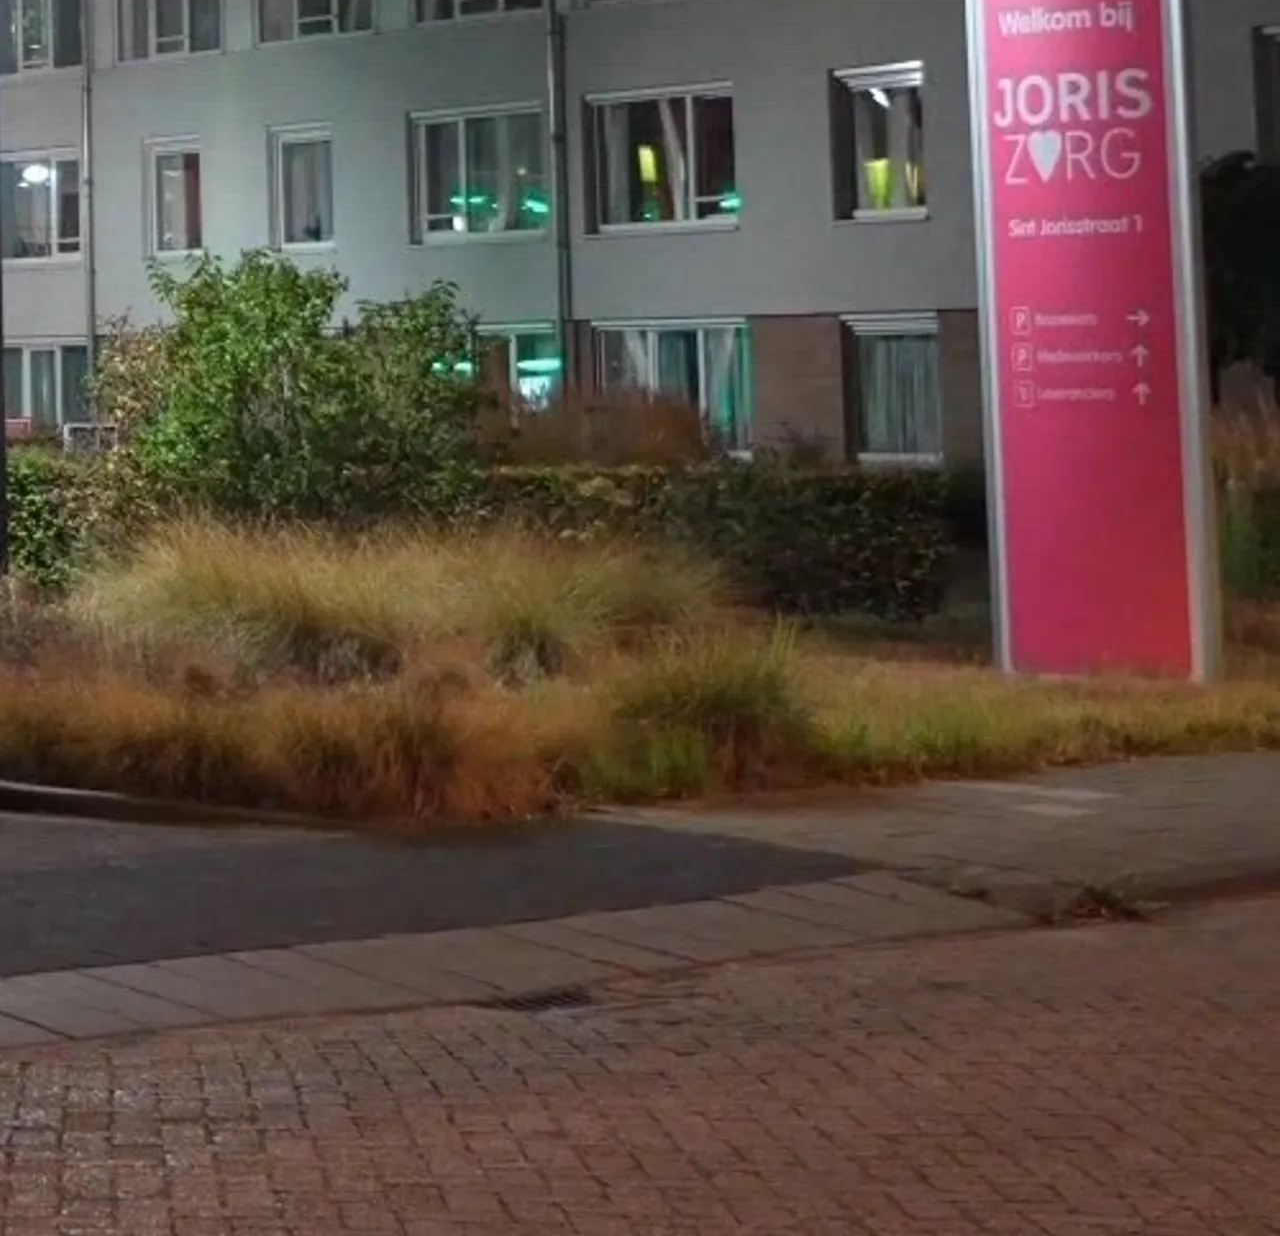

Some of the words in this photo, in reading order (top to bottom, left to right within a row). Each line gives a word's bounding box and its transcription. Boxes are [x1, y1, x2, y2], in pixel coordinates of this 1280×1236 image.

[998, 7, 1092, 37] Welkom
[1100, 0, 1134, 33] bij
[993, 67, 1154, 129] JORIS
